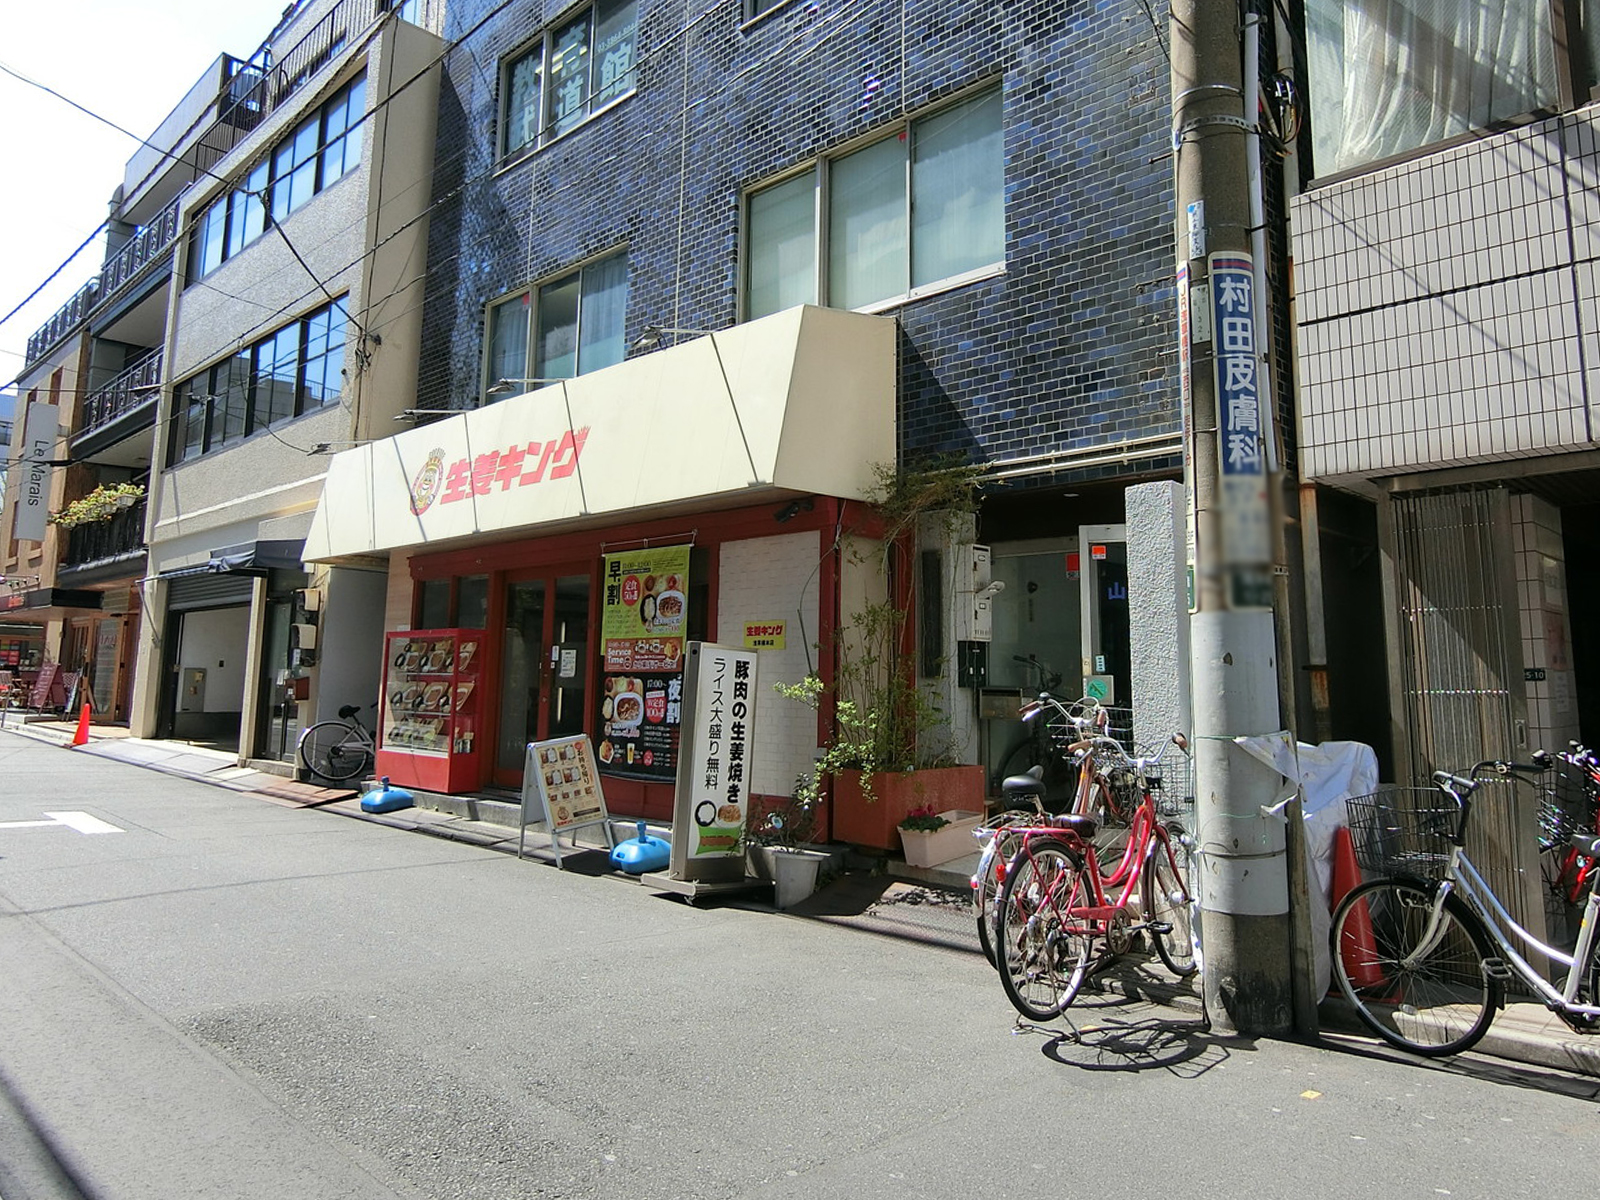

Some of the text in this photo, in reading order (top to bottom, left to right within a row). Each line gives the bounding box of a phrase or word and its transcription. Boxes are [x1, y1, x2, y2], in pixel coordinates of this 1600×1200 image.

[1219, 276, 1260, 470] 村田皮膚科
[28, 439, 49, 507] Le Marais
[439, 424, 592, 505] 生姜キング
[607, 656, 624, 664] Time
[704, 657, 726, 790] ライス大盛り無料
[727, 660, 750, 804] 豚肉の生姜焼き
